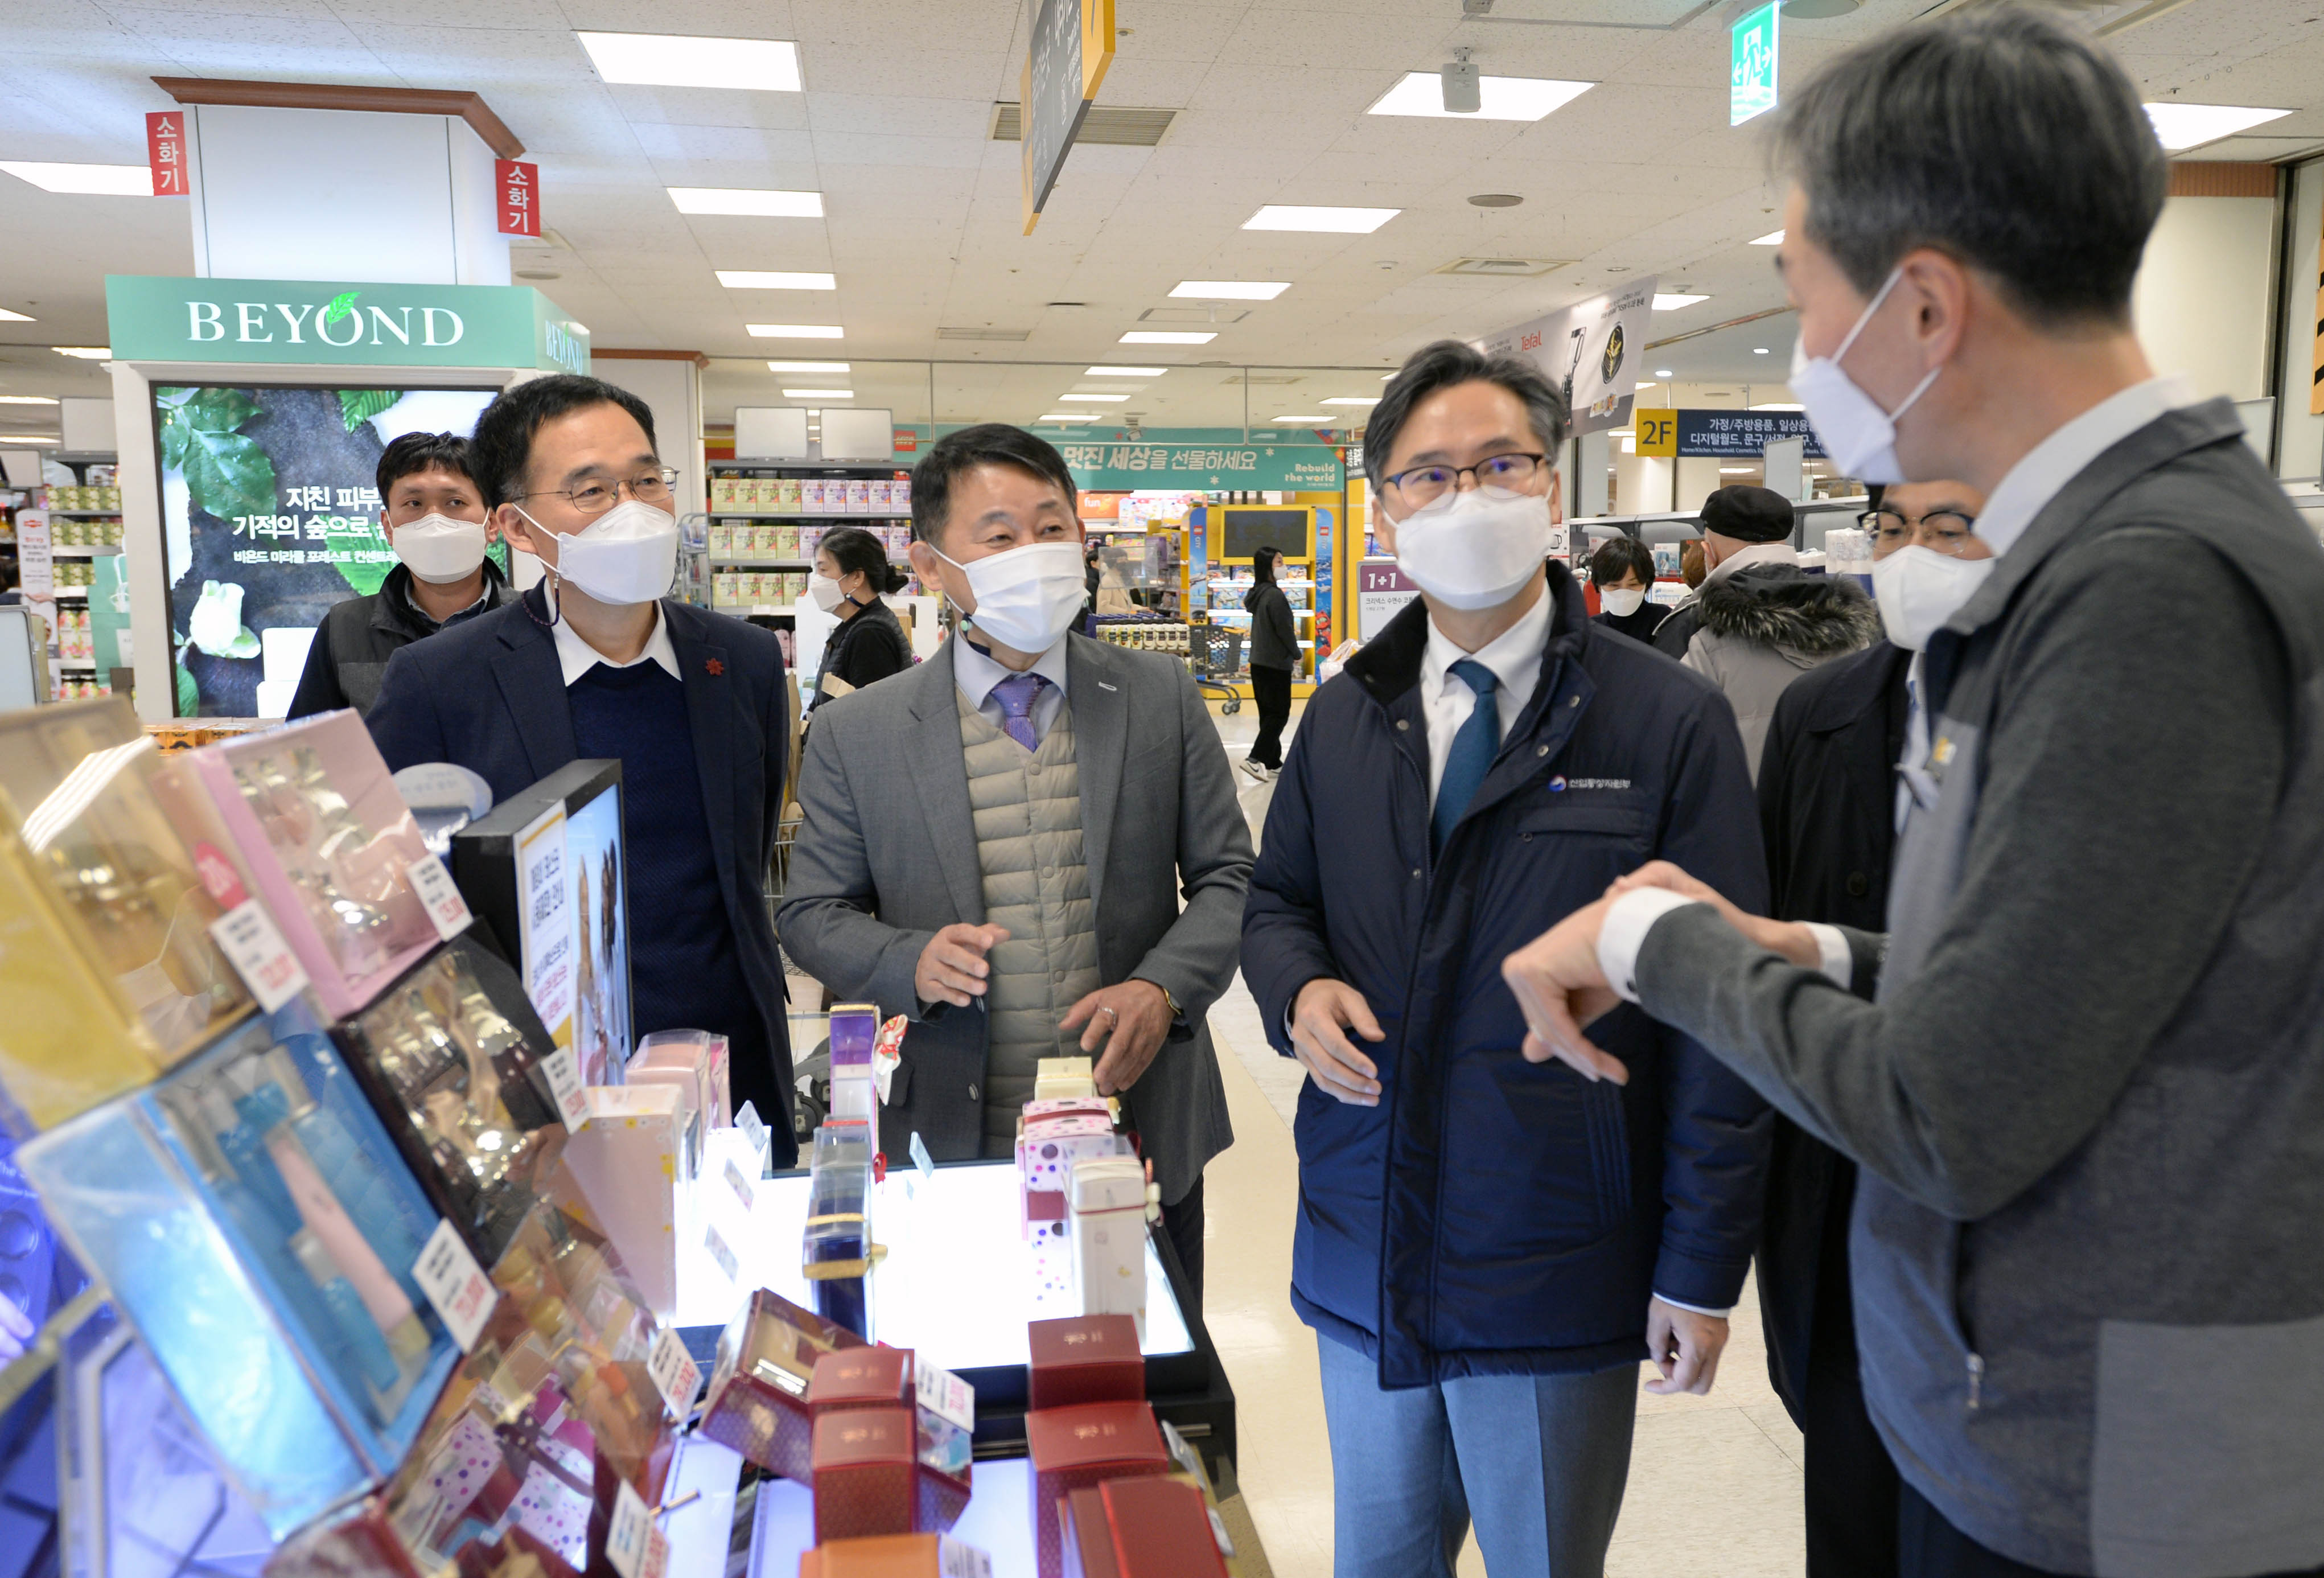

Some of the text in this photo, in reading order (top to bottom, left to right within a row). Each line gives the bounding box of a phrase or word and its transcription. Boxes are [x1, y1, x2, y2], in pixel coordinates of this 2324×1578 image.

[156, 117, 180, 192] 소화기
[507, 165, 530, 233] 소화기
[184, 301, 464, 347] BEYOND
[546, 319, 583, 376] BEYOND
[1521, 330, 1542, 351] Tefal
[1642, 420, 1672, 445] 2F
[1779, 419, 1812, 432] 일상용
[1063, 446, 1257, 470] 멋진 세상을 선물하세요
[1295, 463, 1335, 472] Rebuild
[1285, 472, 1335, 482] the world
[286, 486, 386, 511] 지친 피부
[1084, 497, 1101, 508] fun
[232, 514, 299, 540] 기적의
[304, 514, 373, 540] 숲으로
[1368, 572, 1397, 589] 1+1
